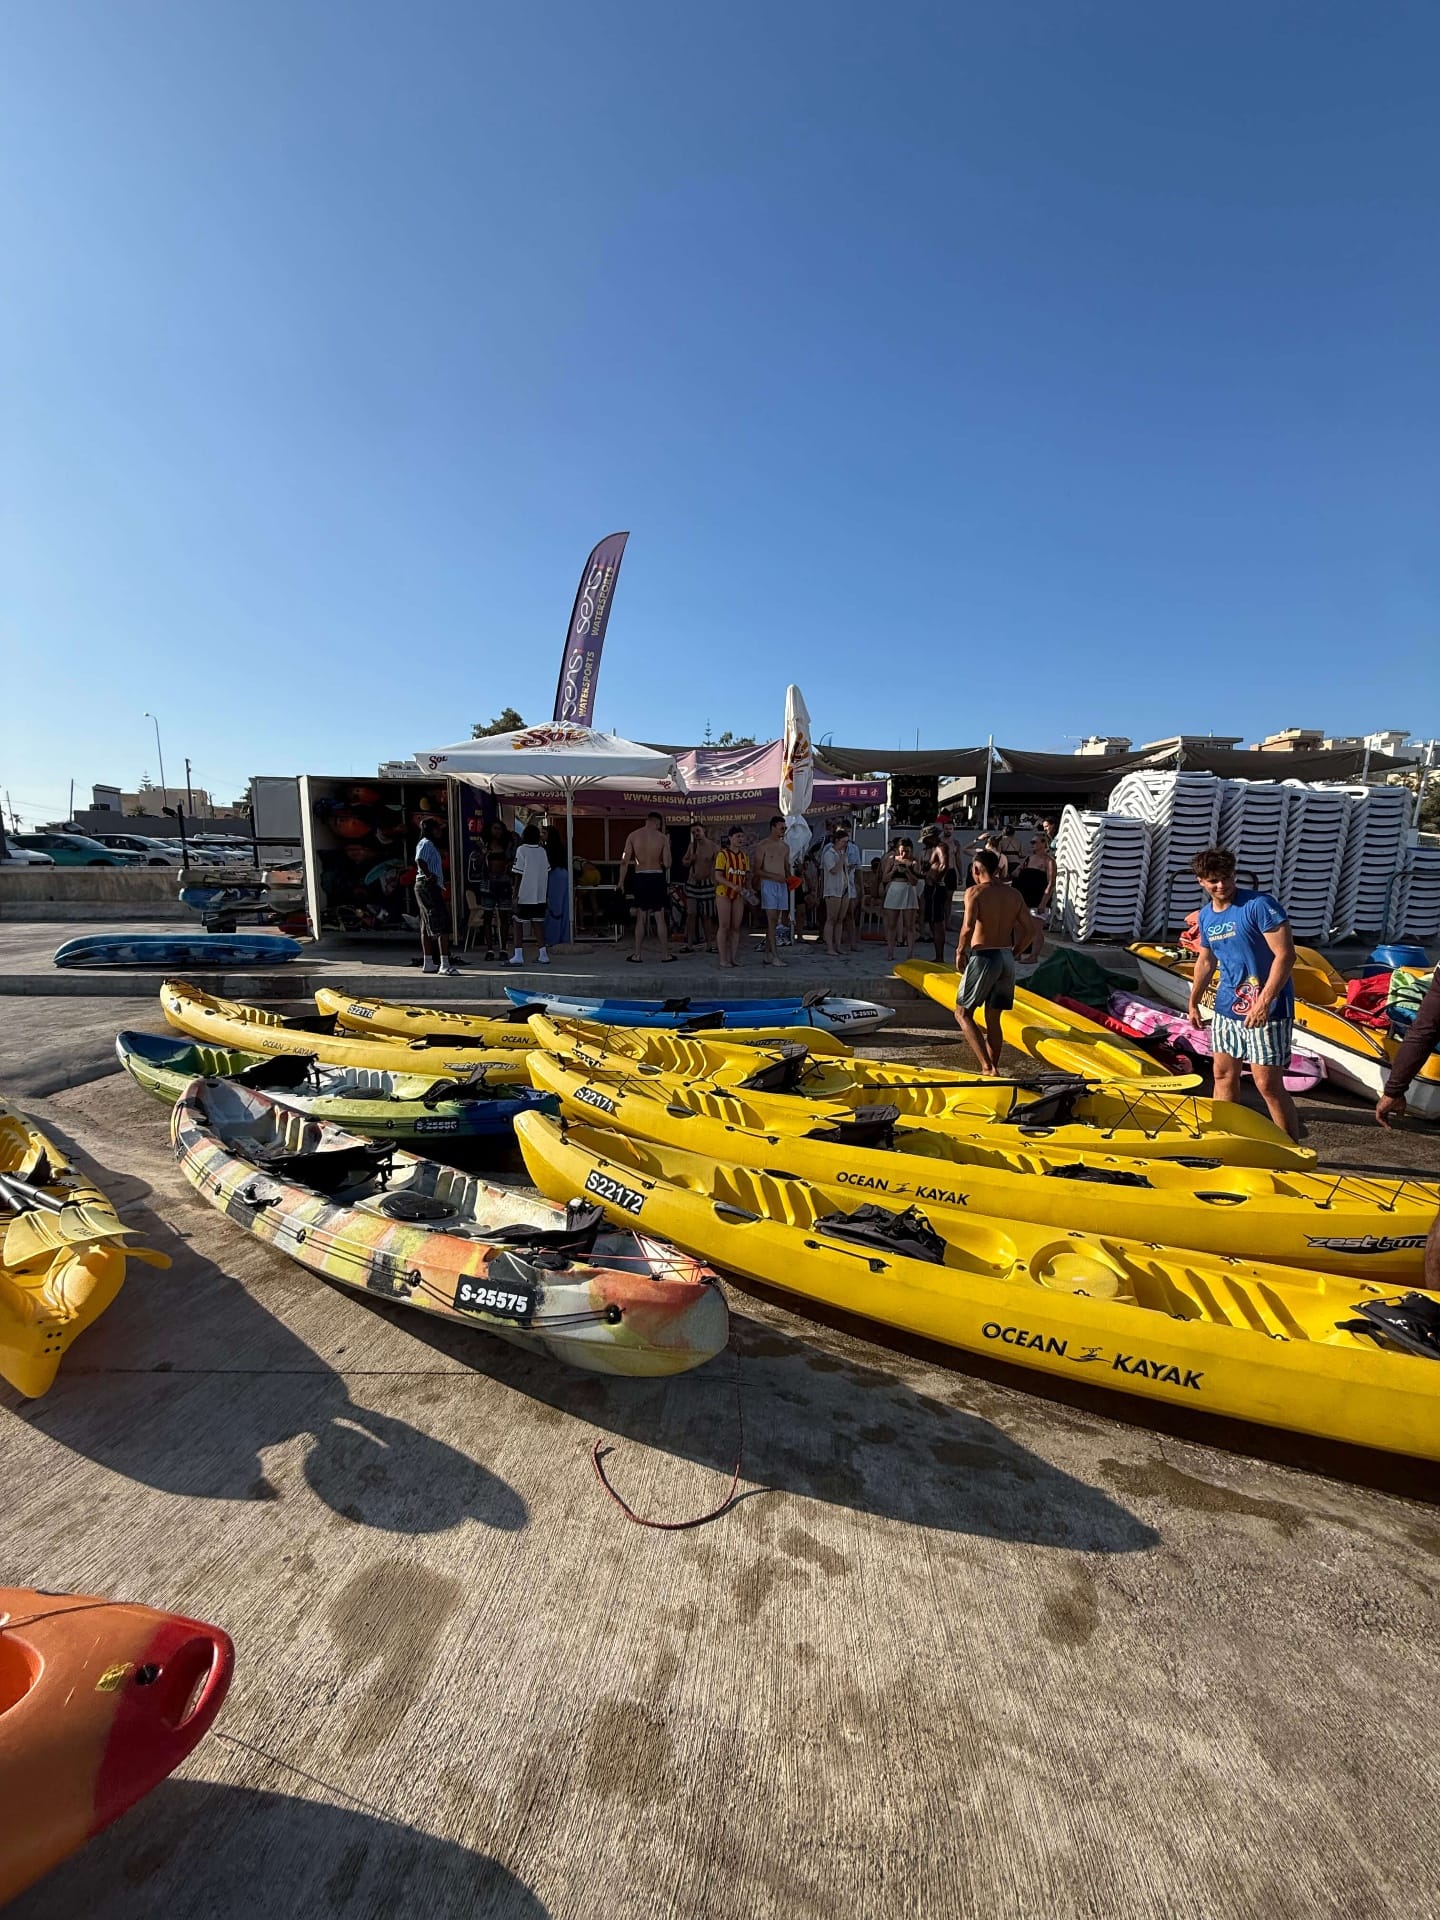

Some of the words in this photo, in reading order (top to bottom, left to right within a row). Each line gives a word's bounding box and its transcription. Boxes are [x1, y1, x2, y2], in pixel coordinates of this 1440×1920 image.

[591, 566, 614, 636] WATERSPORTS
[578, 651, 595, 718] WATERSPORTS
[624, 789, 762, 805] WWW.SENSIWATERSPORTS.COM
[262, 1040, 284, 1050] OCEAN
[501, 1035, 529, 1044] OCEAN
[576, 1087, 614, 1113] S22171
[587, 1172, 643, 1213] S22172
[836, 1171, 889, 1191] OCEAN
[915, 1185, 970, 1206] KAYAK
[460, 1284, 528, 1313] S-25575
[981, 1321, 1068, 1357] OCEAN
[1111, 1353, 1204, 1390] KAYAK
